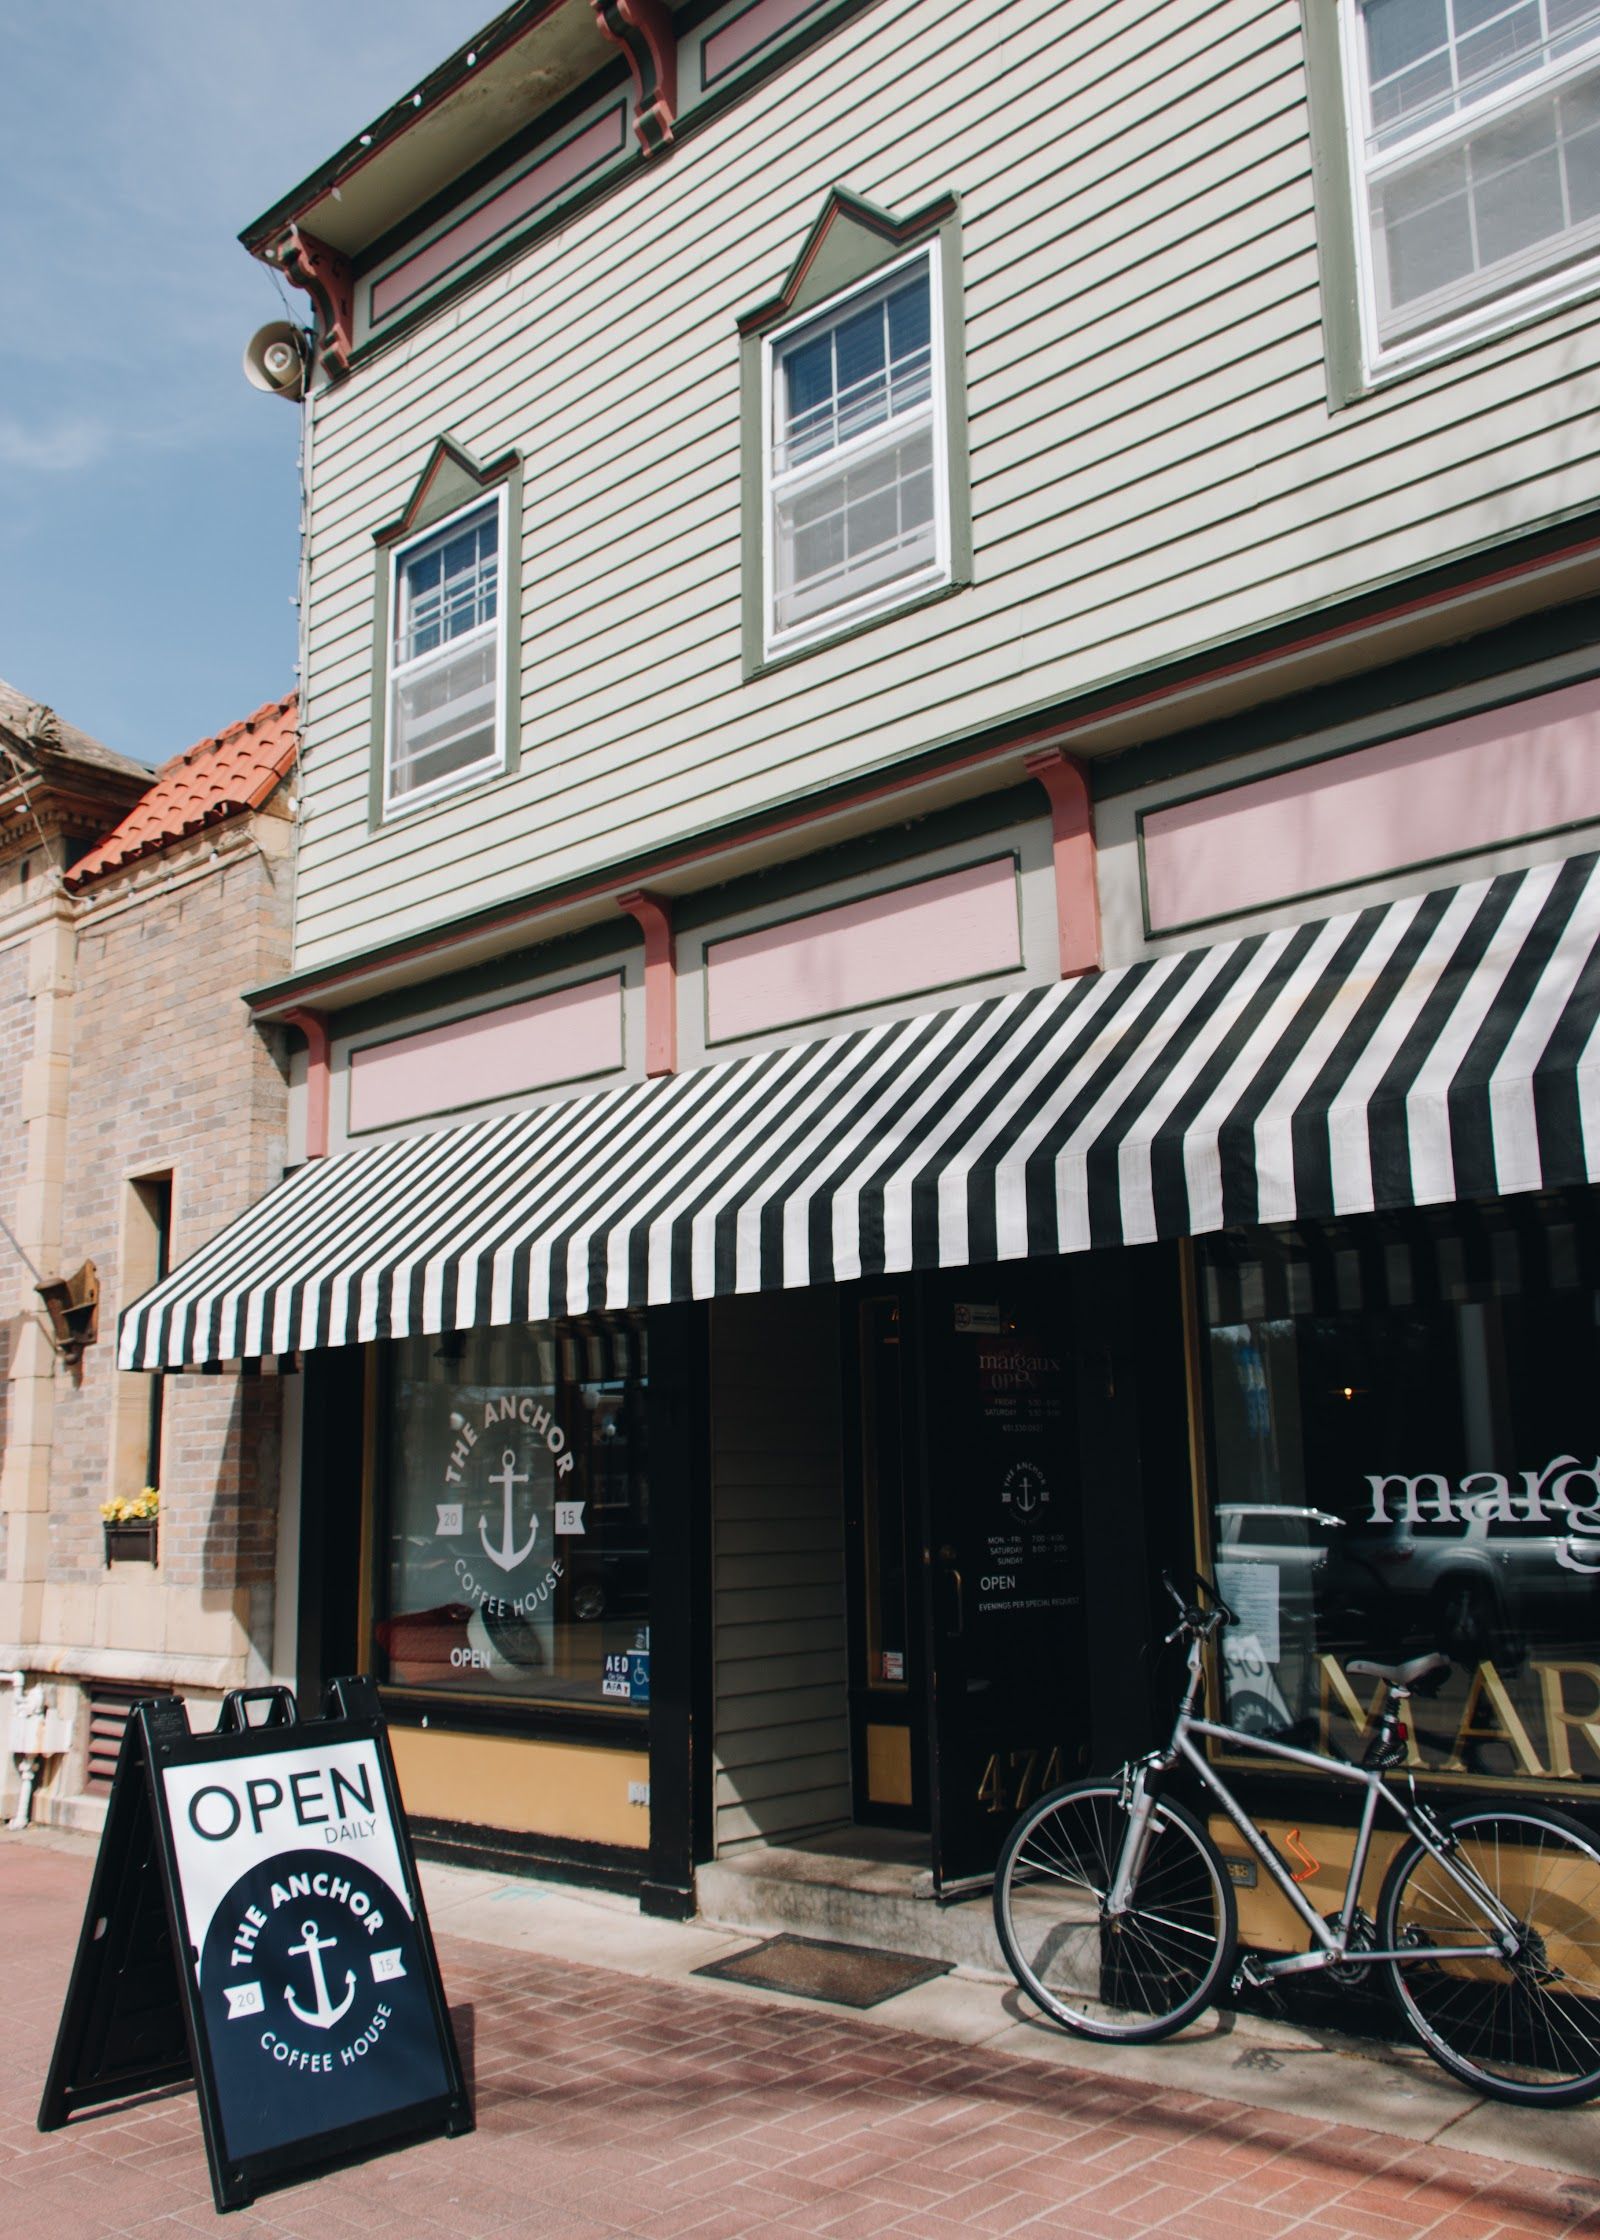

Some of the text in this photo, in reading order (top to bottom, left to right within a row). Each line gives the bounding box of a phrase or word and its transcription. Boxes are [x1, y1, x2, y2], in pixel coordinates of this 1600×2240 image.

[984, 1408, 1017, 1416] SATURDAY
[445, 1395, 574, 1486] THE ANCHOR
[1016, 1461, 1047, 1485] ANCHOR
[443, 1511, 458, 1527] 20
[561, 1510, 575, 1525] 15
[990, 1546, 1023, 1556] SATURDAY
[997, 1557, 1023, 1565] SUNDAY
[454, 1559, 564, 1617] COFFEE HOUSE
[980, 1575, 1016, 1591] OPEN
[979, 1602, 1012, 1612] EVENINGS
[1026, 1599, 1050, 1608] SPECIAL
[1052, 1596, 1080, 1605] REQUEST
[450, 1647, 491, 1669] OPEN
[606, 1655, 629, 1673] AED
[188, 1762, 376, 1841] OPEN
[325, 1818, 377, 1845] DAILY
[230, 1872, 385, 1968] THE ANCHOR
[378, 1957, 394, 1973] 15
[237, 1991, 256, 2009] 20
[260, 2003, 393, 2073] COFFEE HOUSE
